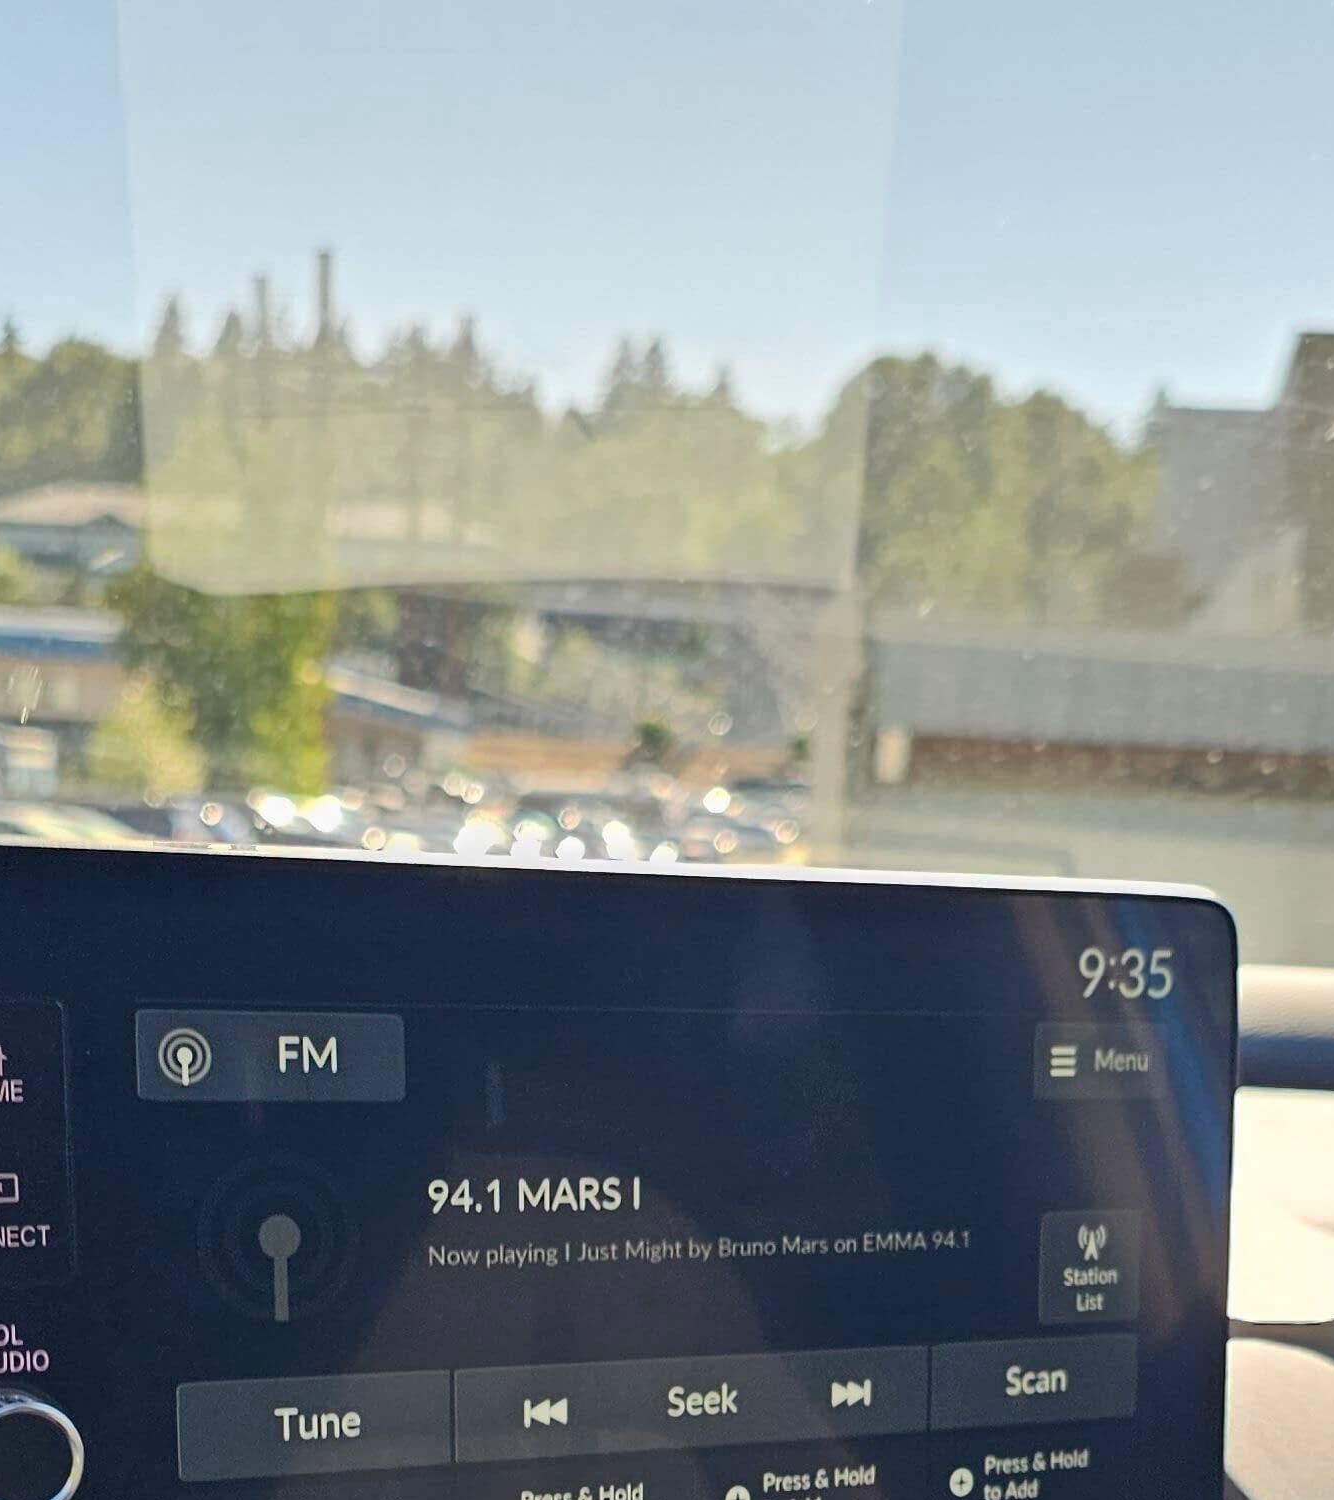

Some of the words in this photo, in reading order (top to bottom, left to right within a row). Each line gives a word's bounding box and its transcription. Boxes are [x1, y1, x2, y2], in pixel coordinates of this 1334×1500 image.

[1079, 947, 1173, 998] 9:35
[278, 1036, 337, 1073] FM
[1093, 1048, 1149, 1072] Menu
[427, 1179, 500, 1214] 94.1
[518, 1177, 623, 1212] MARS
[428, 1245, 480, 1266] Now
[486, 1243, 558, 1268] playing
[578, 1241, 618, 1262] Just
[625, 1239, 681, 1264] Might
[688, 1237, 713, 1262] by
[718, 1236, 776, 1258] Bruno
[782, 1234, 828, 1255] Mars
[834, 1238, 857, 1254] on
[863, 1231, 926, 1252] EMMA
[931, 1229, 970, 1250] 94.1
[1063, 1267, 1117, 1286] Station
[1076, 1293, 1105, 1312] List
[1006, 1365, 1067, 1396] Scan
[668, 1382, 738, 1418] Seek
[274, 1406, 361, 1441] Tune
[984, 1454, 1028, 1475] Press
[1033, 1451, 1046, 1472] &
[1051, 1449, 1090, 1470] Hold
[763, 1472, 811, 1493] Press
[815, 1468, 829, 1489] &
[834, 1465, 876, 1488] Hold
[1005, 1478, 1039, 1500] Add
